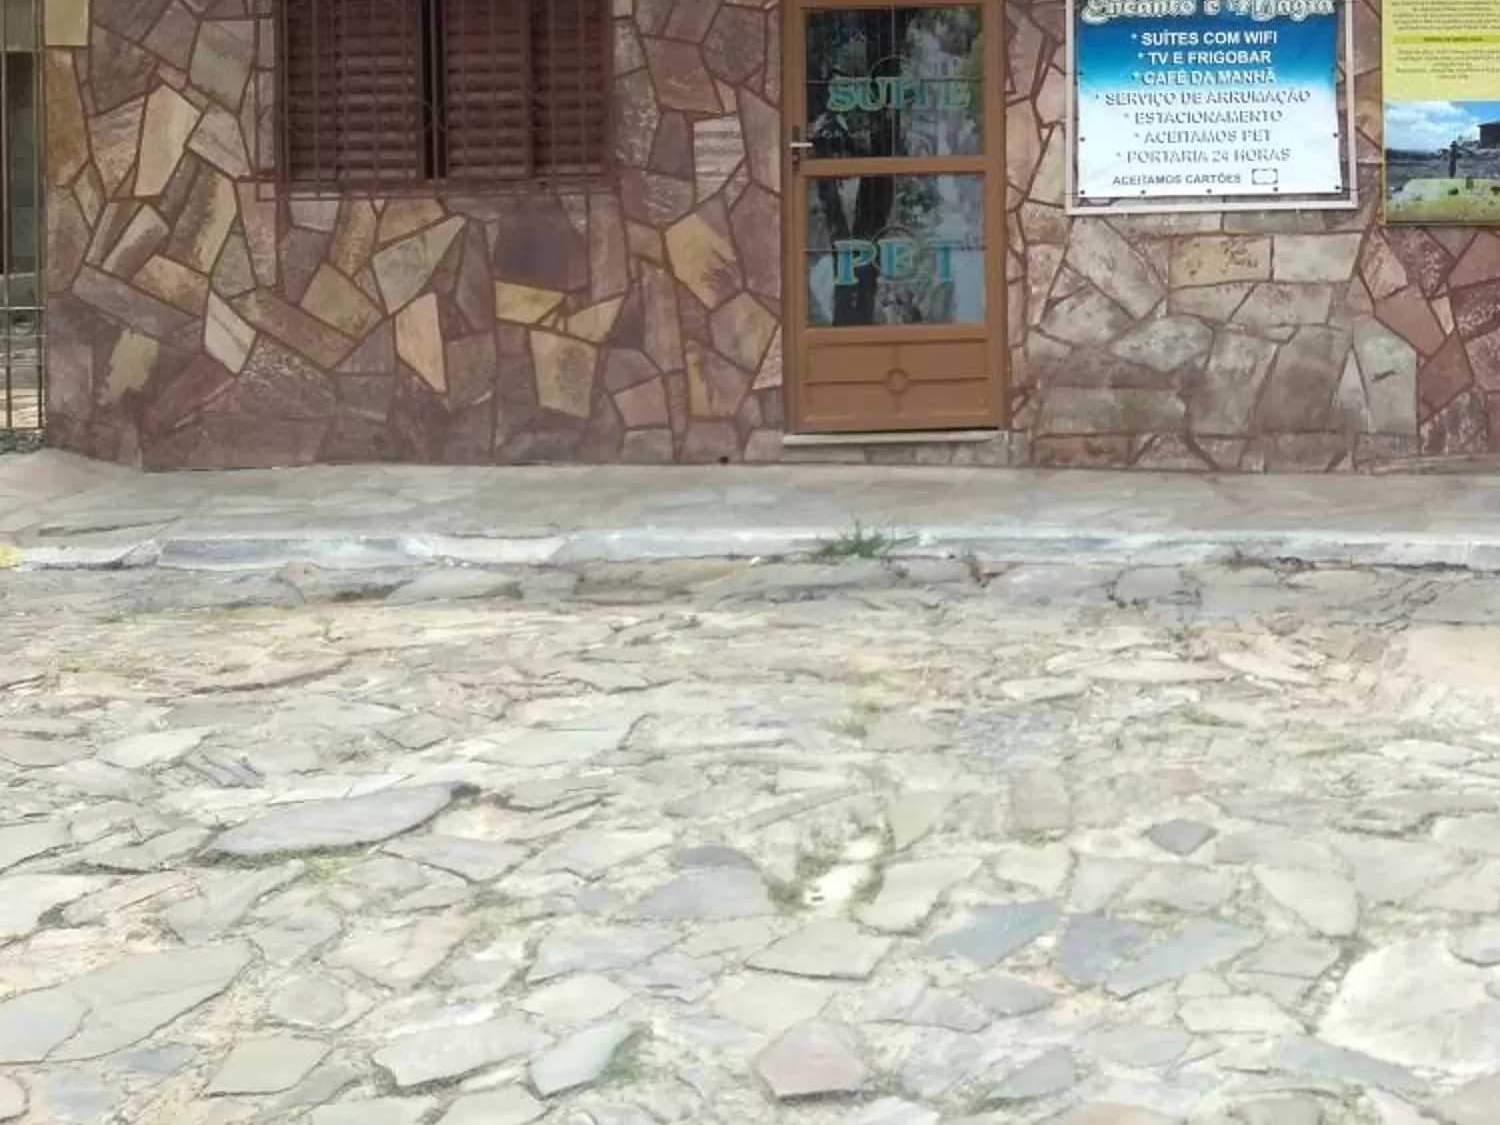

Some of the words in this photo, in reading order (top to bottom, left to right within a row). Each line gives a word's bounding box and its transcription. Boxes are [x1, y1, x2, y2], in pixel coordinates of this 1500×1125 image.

[1141, 29, 1199, 46] SUÍTES
[1203, 31, 1239, 44] COM
[1244, 30, 1277, 44] WIFI
[1149, 52, 1168, 65] TV
[1173, 51, 1183, 64] E
[1188, 50, 1272, 64] FRIGOBAR
[1141, 70, 1188, 86] CAFÉ
[1191, 72, 1215, 85] DA
[1218, 67, 1276, 84] MANHÃ
[1105, 91, 1176, 107] SERVIÇO
[1181, 91, 1203, 104] DE
[1135, 110, 1284, 124] ESTACIONAMENTO
[1144, 130, 1237, 144] ACEITAMOS
[1242, 129, 1271, 143] PET
[1127, 150, 1208, 164] PORTARIA
[1211, 150, 1228, 163] 24
[1234, 148, 1291, 163] HORAS
[1112, 174, 1182, 186] ACEITAMOS
[1185, 173, 1242, 185] CARTÕES
[834, 239, 965, 287] PET
